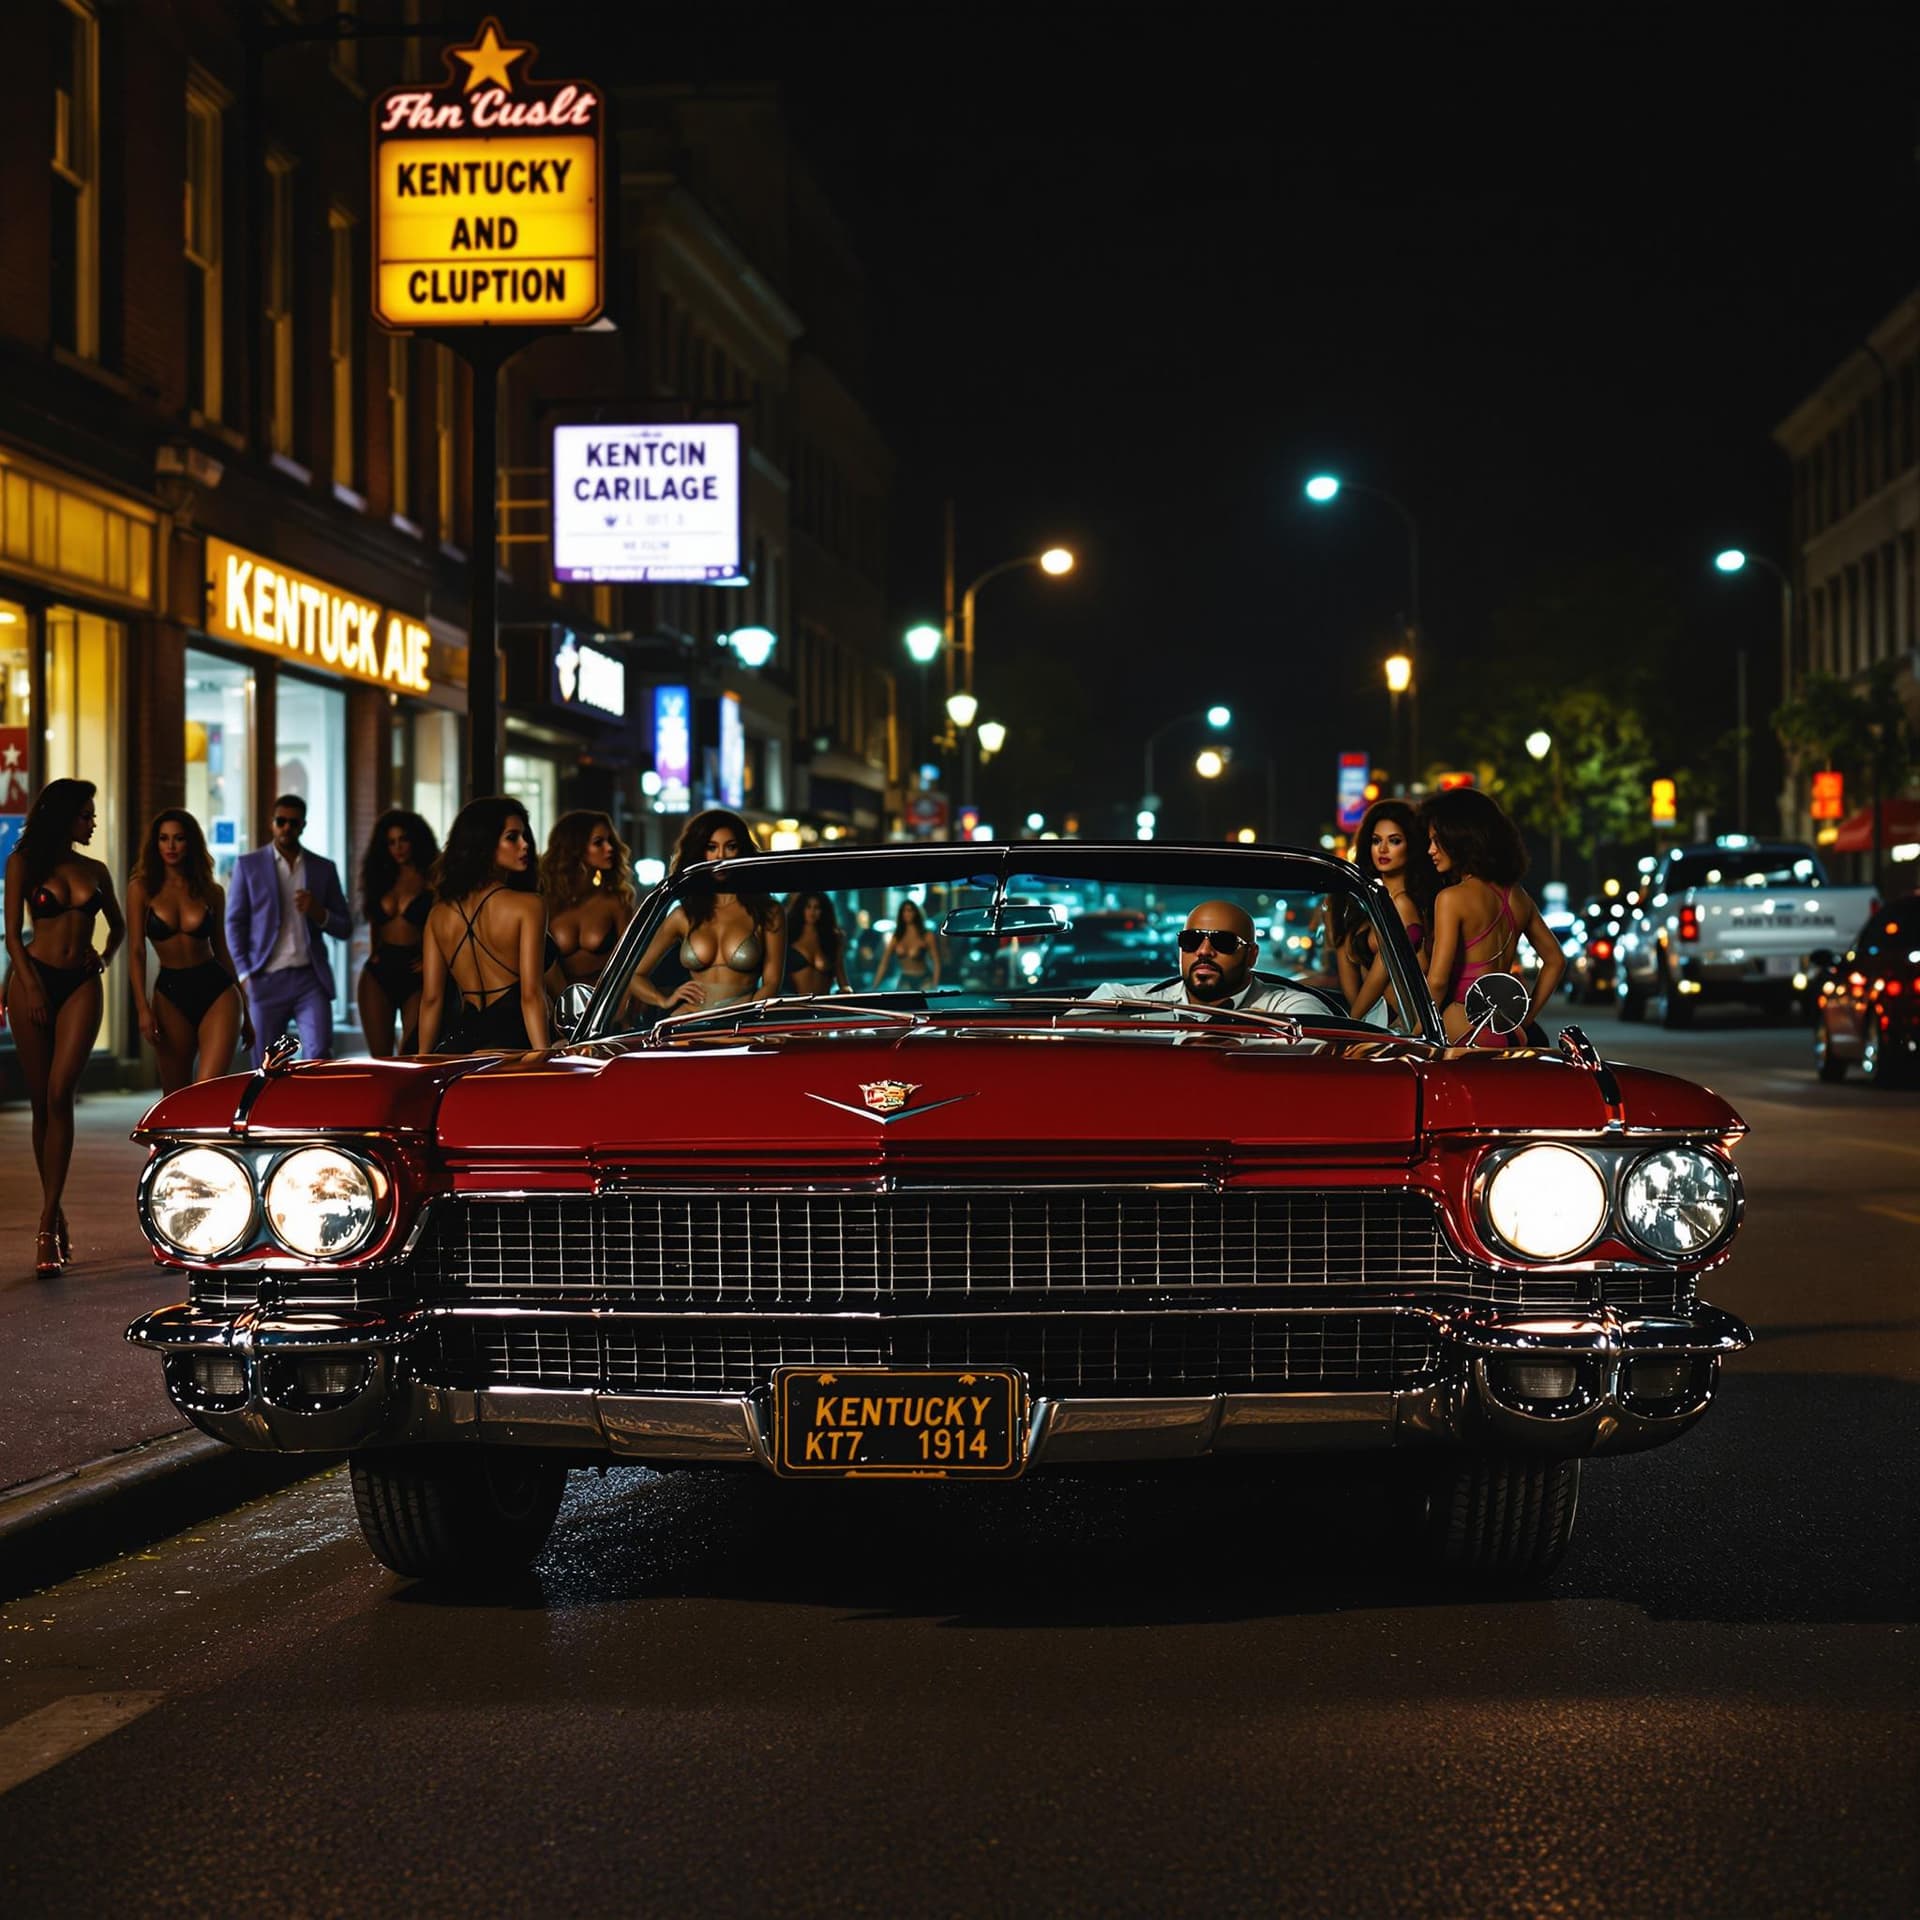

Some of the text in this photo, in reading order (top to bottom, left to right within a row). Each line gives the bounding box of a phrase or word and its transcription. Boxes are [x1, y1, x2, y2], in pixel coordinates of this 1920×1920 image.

[397, 159, 572, 197] KENTUCKY
[451, 217, 518, 251] AND
[408, 269, 566, 304] CLUPTION
[587, 442, 706, 467] KENTCIN
[574, 476, 718, 501] CARILAGE
[225, 554, 380, 678] KENTUCK
[815, 1397, 991, 1426] KENTUCKY
[805, 1430, 988, 1460] KT7 1914
